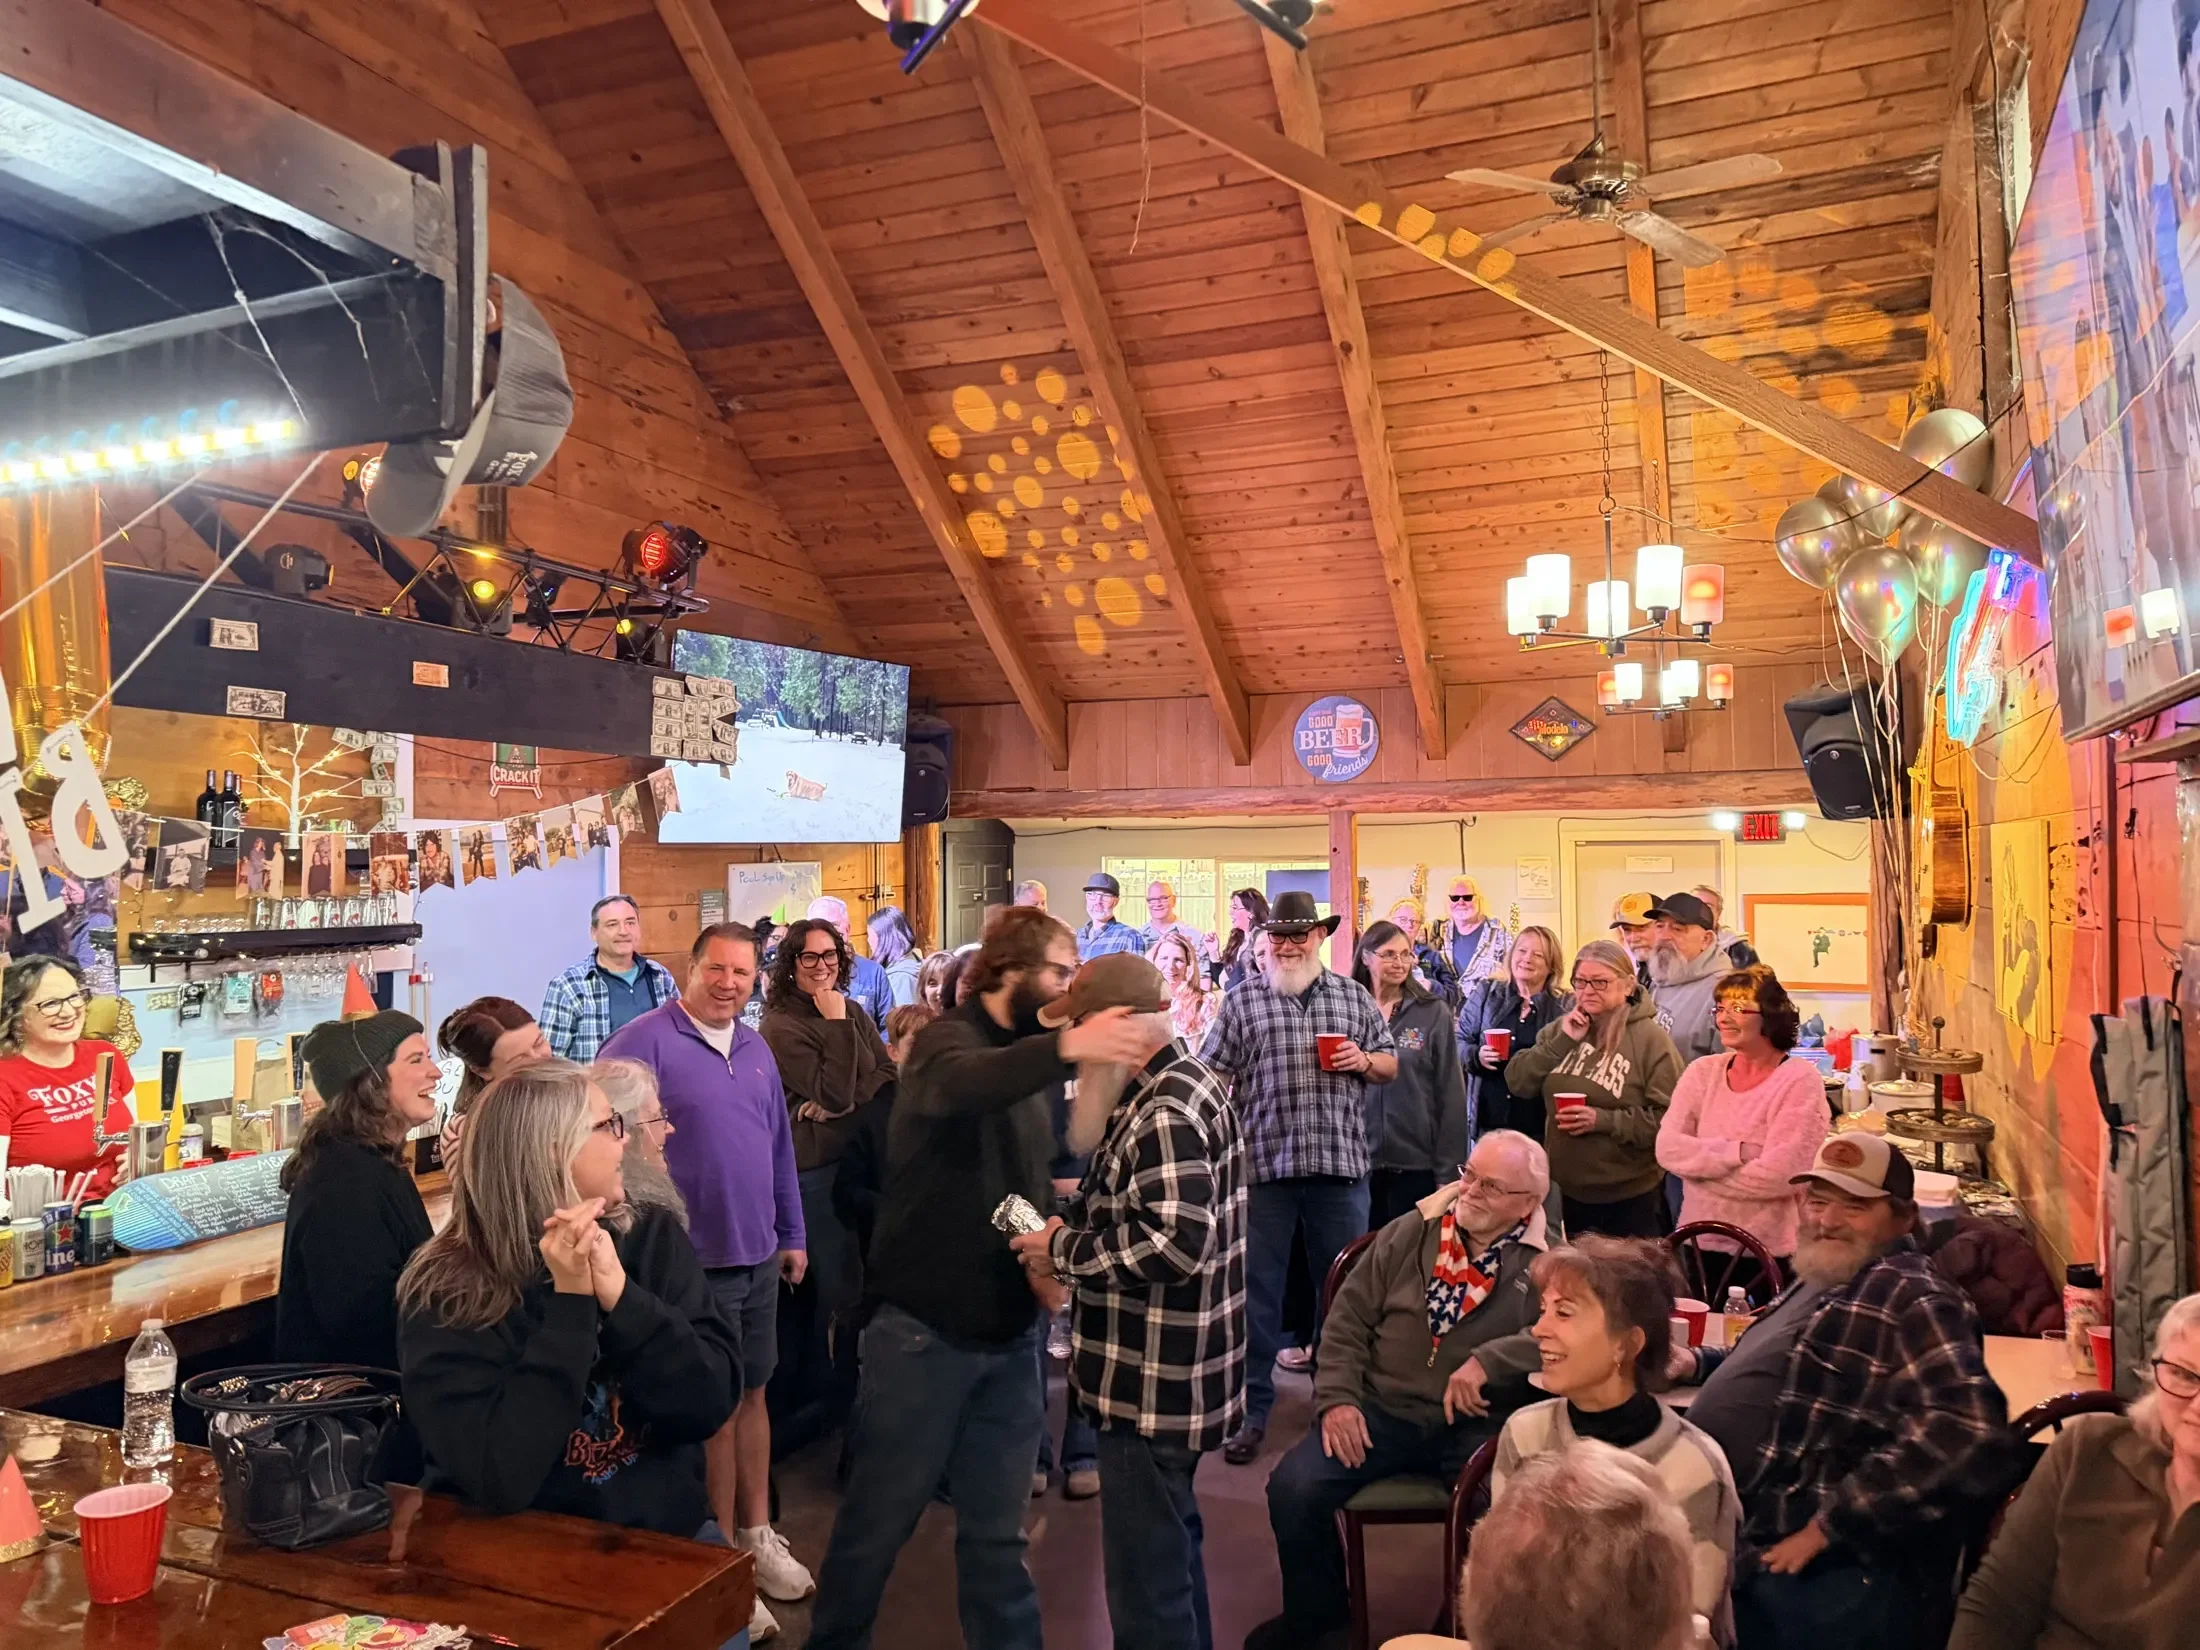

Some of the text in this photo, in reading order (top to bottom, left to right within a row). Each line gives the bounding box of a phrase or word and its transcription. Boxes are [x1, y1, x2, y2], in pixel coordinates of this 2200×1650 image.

[1308, 715, 1334, 729] GOOD
[1298, 727, 1365, 750] BEER
[1307, 753, 1332, 767] GOOD
[1322, 756, 1368, 778] friends
[493, 765, 541, 785] CRACK IT
[1743, 813, 1780, 841] EXIT
[159, 1170, 209, 1190] DRAFT
